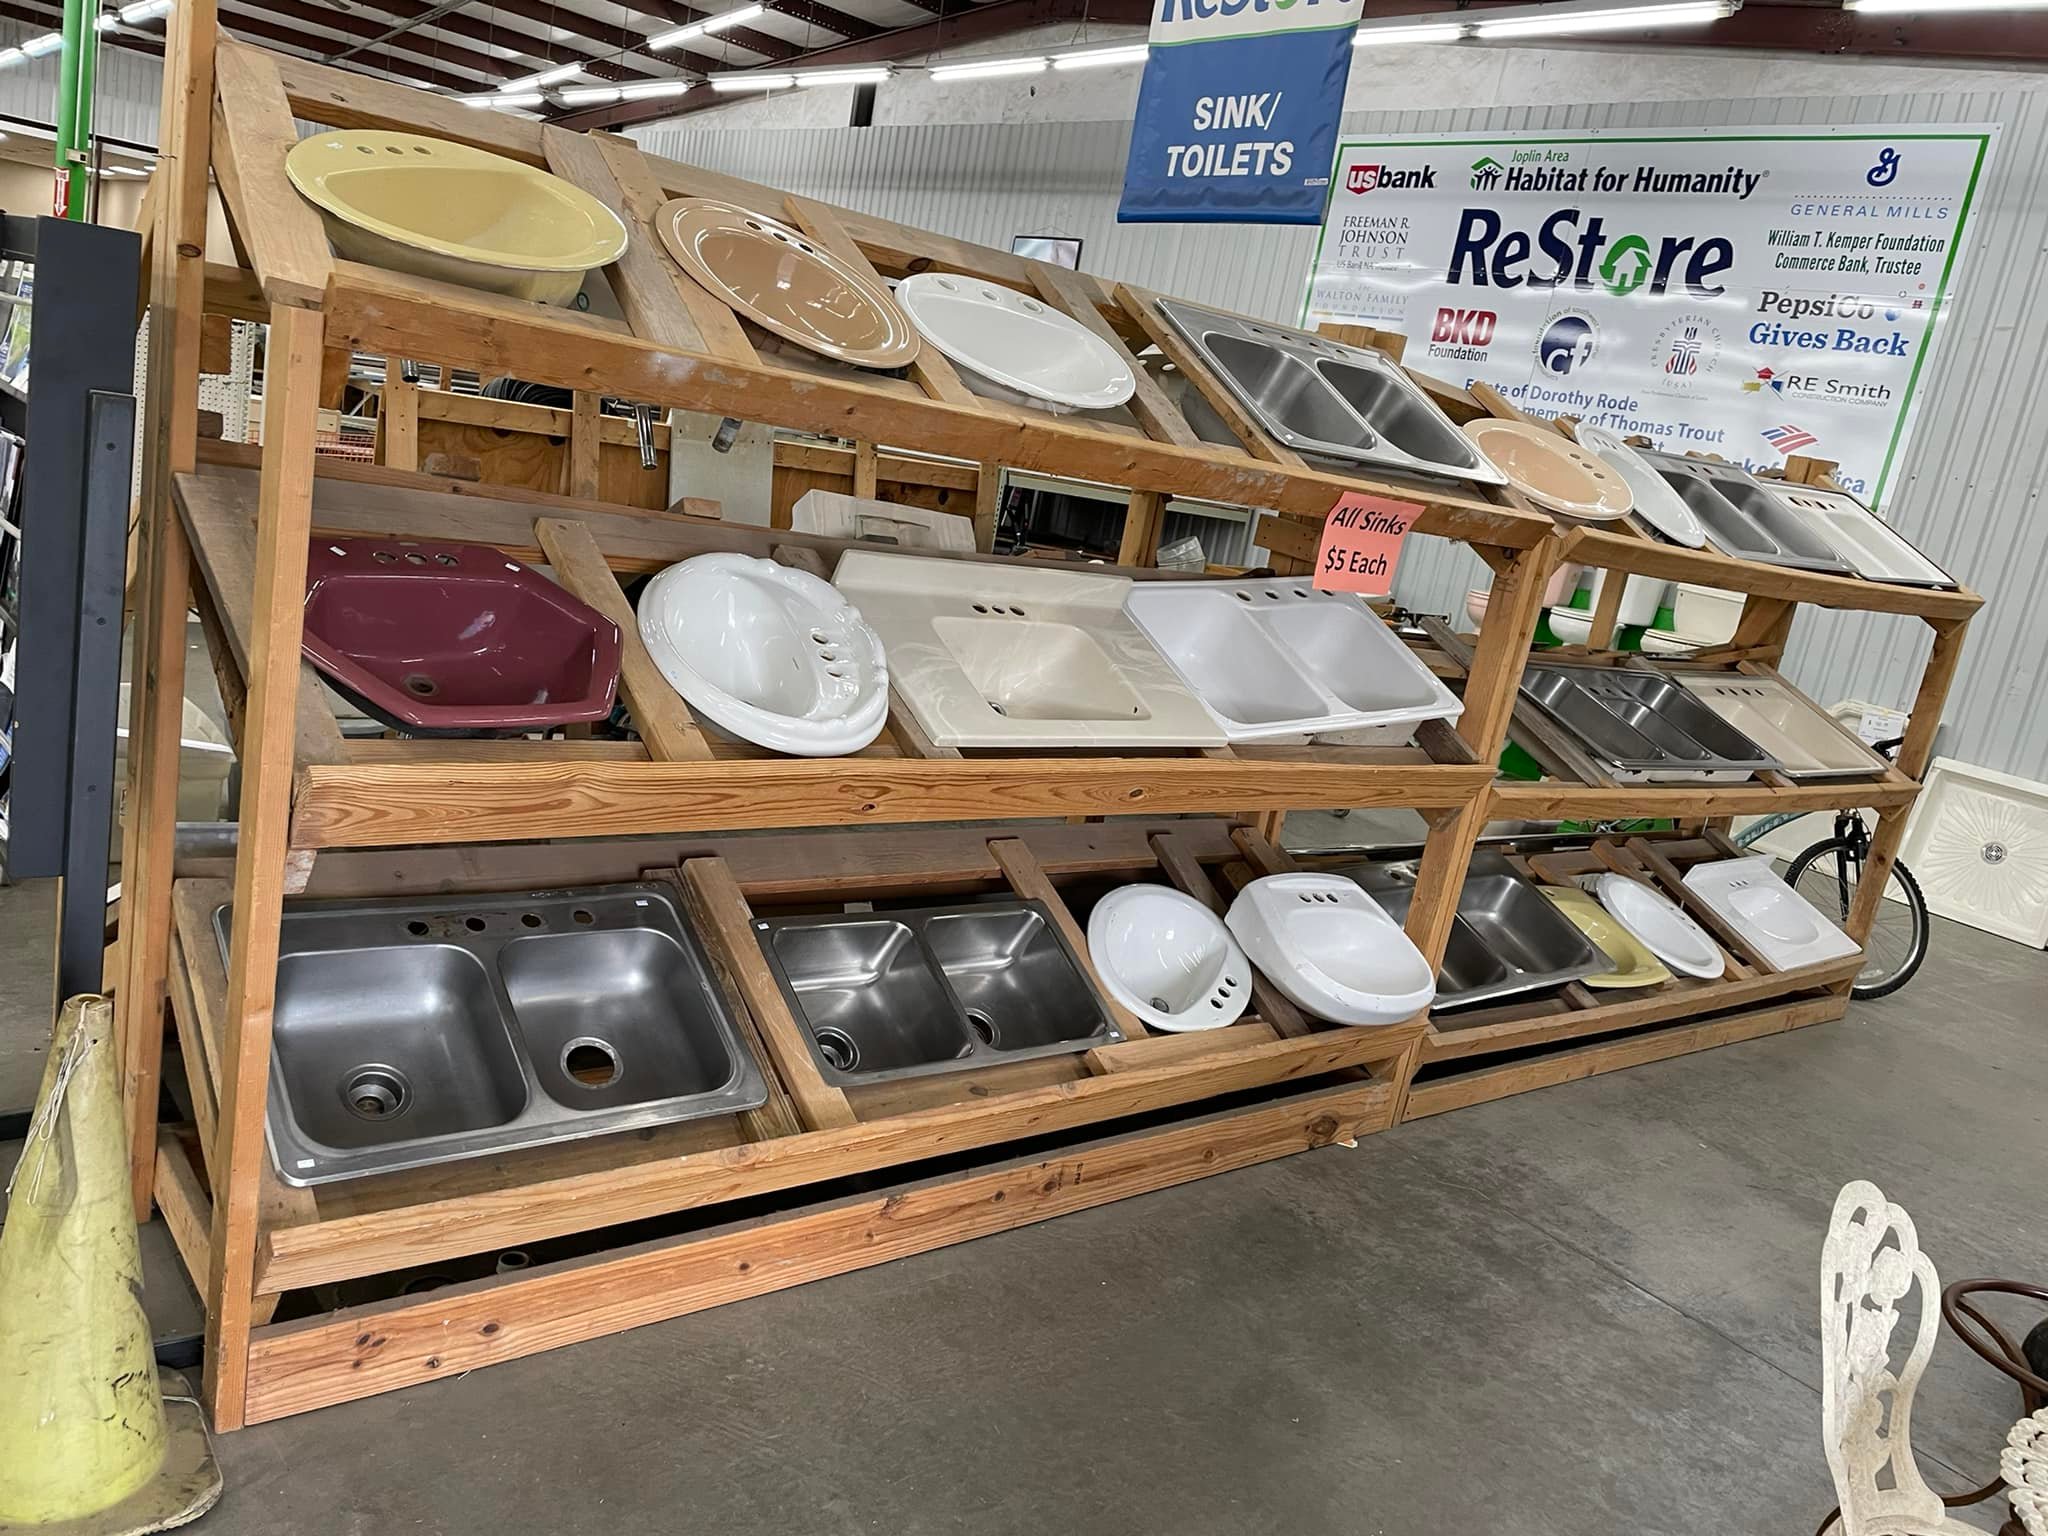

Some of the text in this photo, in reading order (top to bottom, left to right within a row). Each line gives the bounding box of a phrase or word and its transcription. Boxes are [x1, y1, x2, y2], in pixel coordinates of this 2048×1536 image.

[1193, 92, 1282, 130] SINK/
[1167, 141, 1294, 177] TOILETS
[1511, 149, 1570, 165] Joplin Area
[1504, 166, 1588, 191] Habitat
[1592, 166, 1630, 192] for
[1343, 215, 1398, 229] FREEMAN
[1790, 204, 1949, 220] GENERAL MILLS
[1340, 229, 1409, 245] JOHNSON
[1768, 230, 1946, 253] William T. Kemper Foundation
[1339, 244, 1405, 260] TRUST
[1446, 207, 1735, 298] ReStore
[1775, 252, 1922, 276] Commerce Bank, Trustee
[1316, 289, 1409, 306] WALTON FAMILY
[1756, 291, 1875, 320] PepsiCo
[1431, 307, 1497, 347] BKD
[1750, 322, 1910, 357] Gives Back
[1428, 343, 1488, 362] Foundation
[1511, 383, 1529, 398] of
[1530, 385, 1594, 409] Dorothy
[1597, 393, 1639, 412] Rode
[1787, 375, 1892, 400] RE Smith
[1589, 412, 1608, 428] of
[1608, 413, 1674, 437] Thomas
[1677, 422, 1726, 443] Trout
[1331, 507, 1407, 536] All Sinks
[1324, 545, 1388, 577] $5 Each
